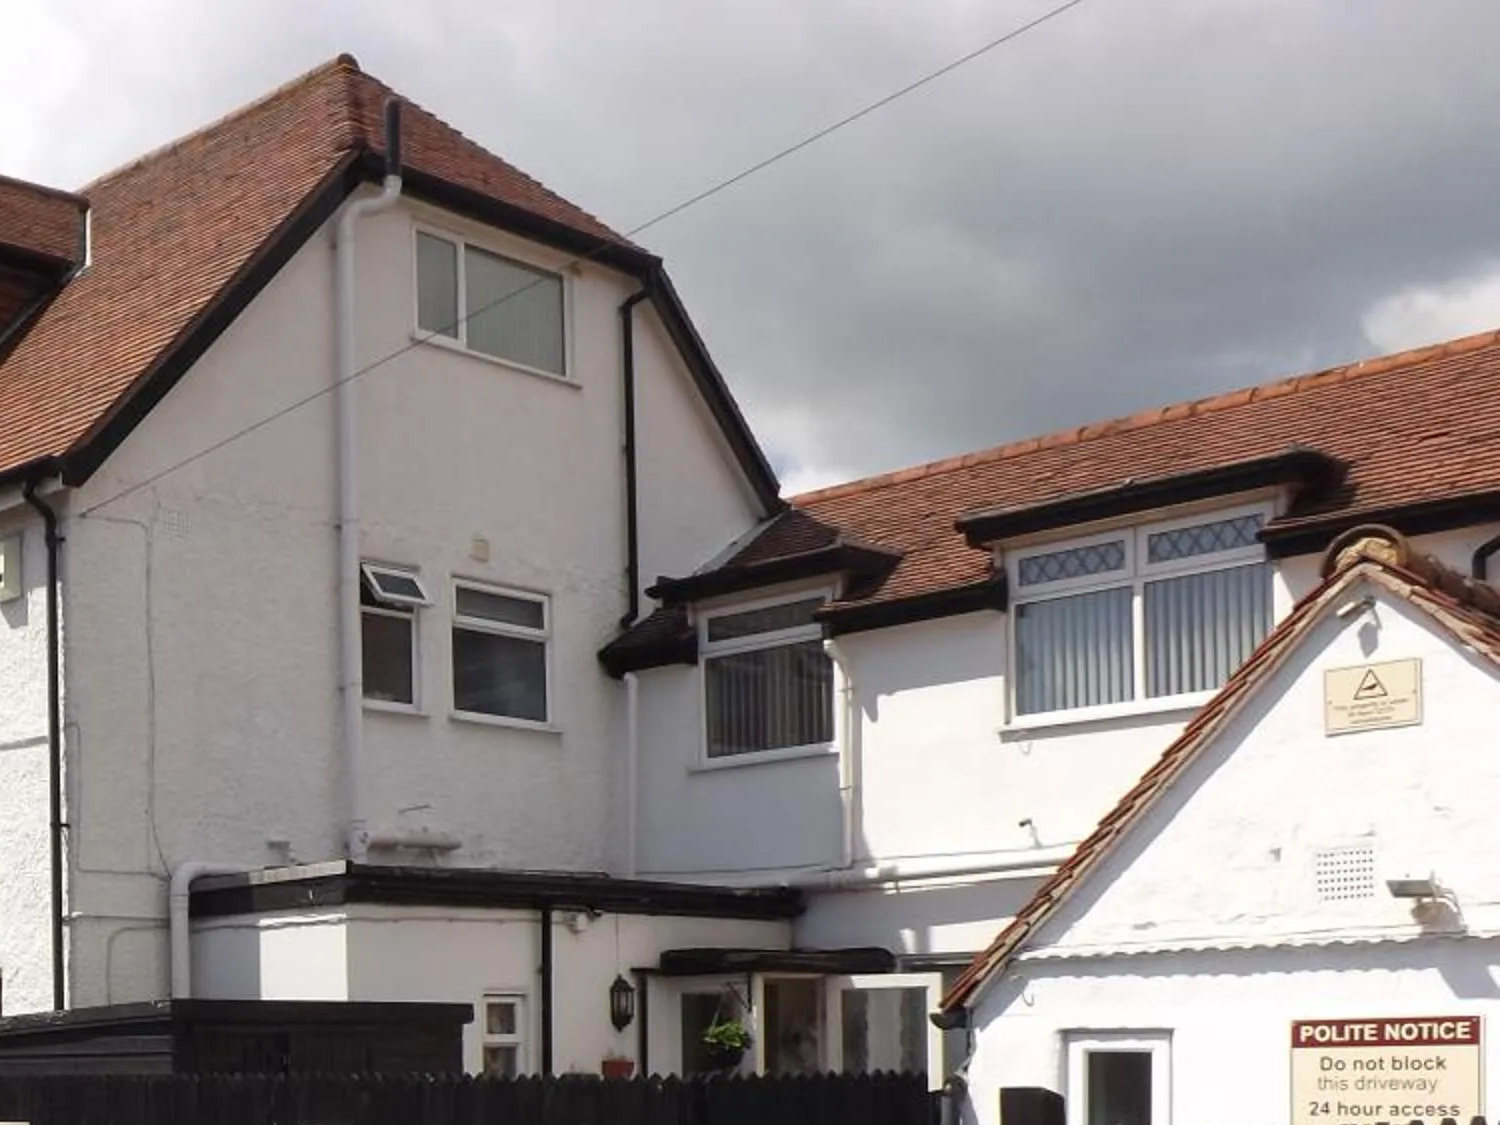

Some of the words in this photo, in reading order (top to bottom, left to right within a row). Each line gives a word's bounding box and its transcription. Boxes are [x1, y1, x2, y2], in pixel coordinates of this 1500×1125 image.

[1299, 1024, 1378, 1043] POLITE
[1384, 1021, 1472, 1041] NOTICE
[1319, 1056, 1346, 1071] Do
[1353, 1057, 1385, 1071] not
[1391, 1055, 1447, 1071] block
[1317, 1076, 1349, 1091] this
[1354, 1076, 1438, 1094] driveway
[1308, 1101, 1331, 1116] 24
[1336, 1101, 1383, 1117] hour
[1389, 1103, 1461, 1117] access
